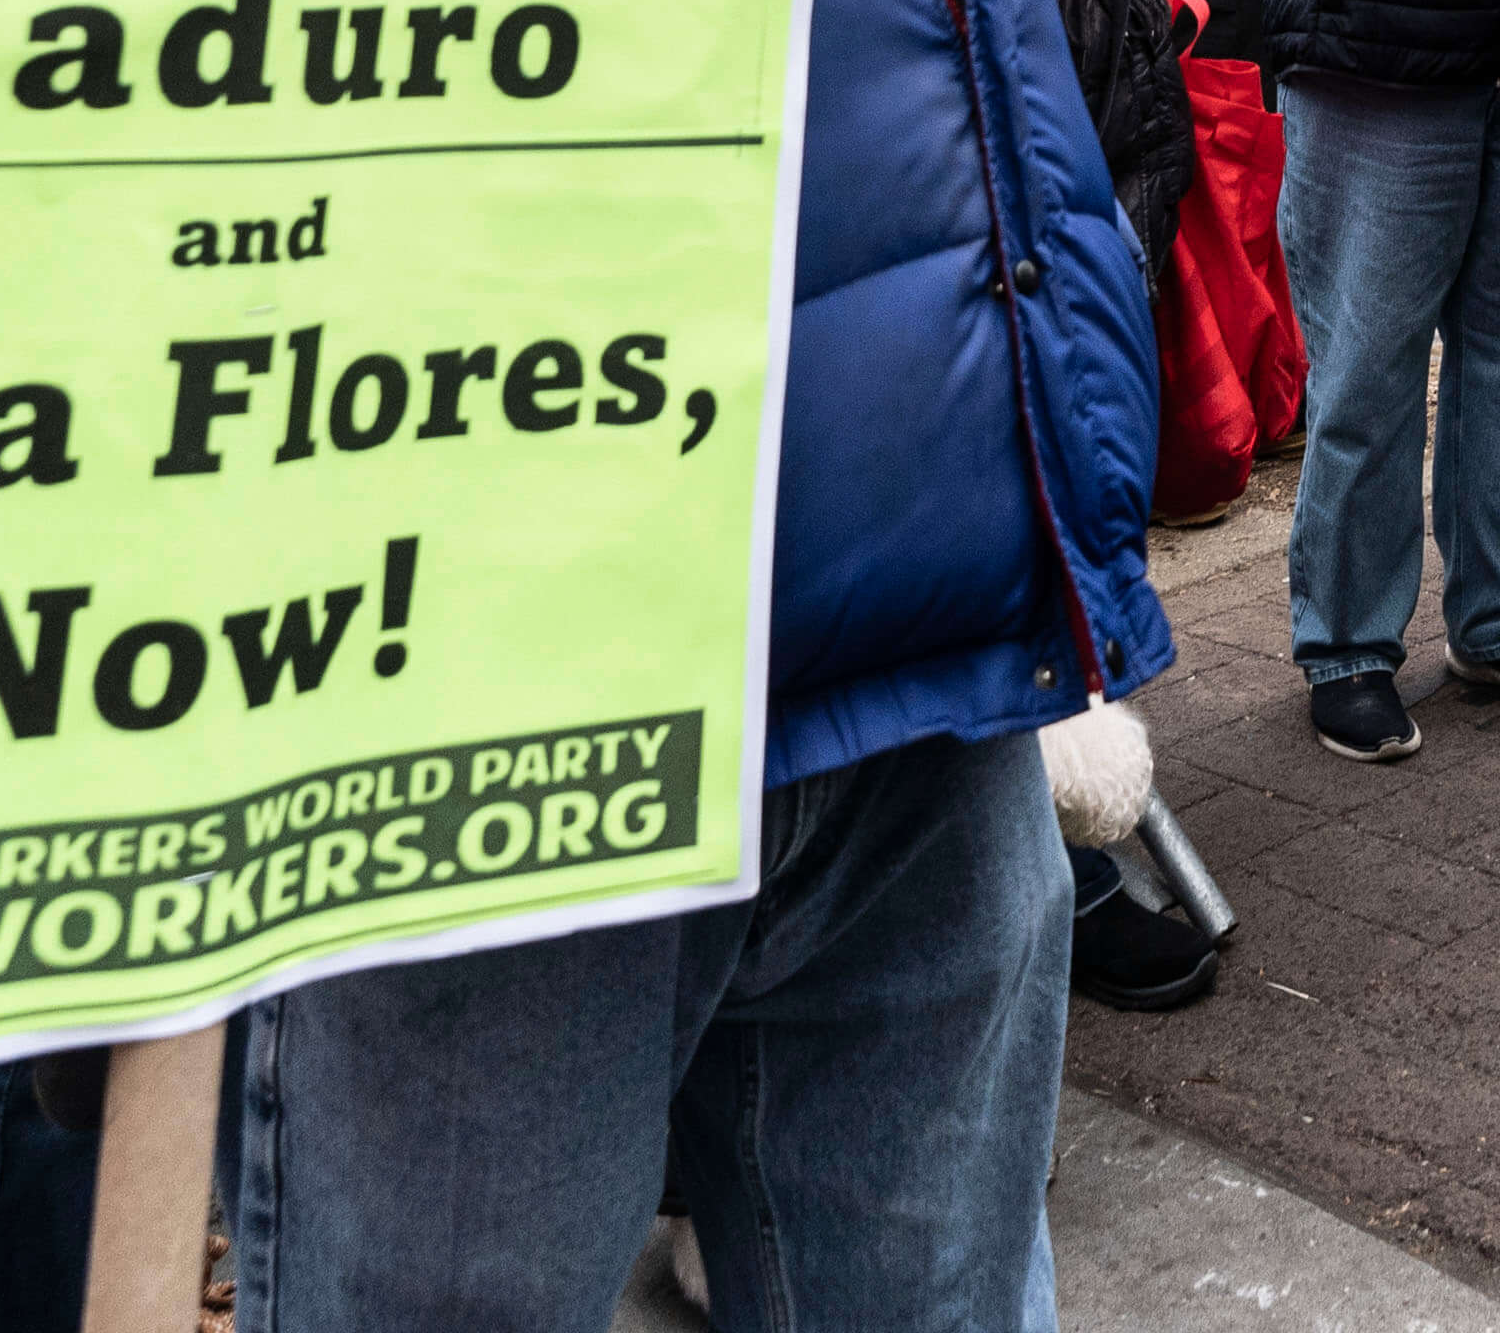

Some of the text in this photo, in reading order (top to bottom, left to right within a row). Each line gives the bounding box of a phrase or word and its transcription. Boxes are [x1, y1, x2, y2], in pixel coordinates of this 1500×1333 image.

[172, 197, 327, 267] and
[153, 325, 716, 477] Flores,
[243, 756, 452, 849] WORLD
[468, 723, 672, 796] PARTY
